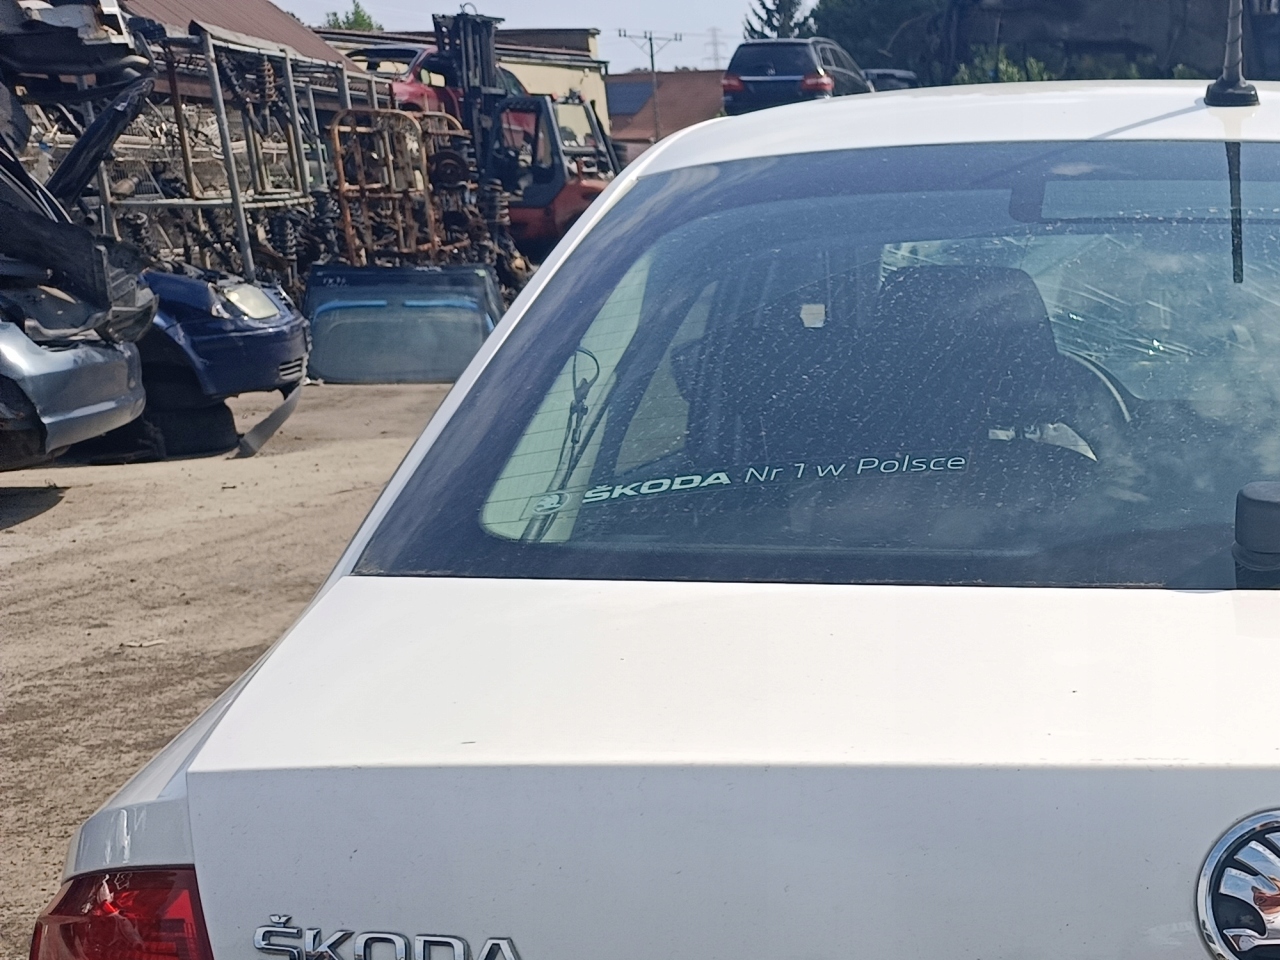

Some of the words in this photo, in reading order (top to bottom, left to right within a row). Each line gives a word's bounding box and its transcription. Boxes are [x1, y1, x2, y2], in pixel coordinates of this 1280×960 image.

[583, 471, 731, 503] ŠKODA
[744, 466, 782, 484] Nr
[795, 463, 806, 479] 1
[856, 454, 966, 475] Polsce
